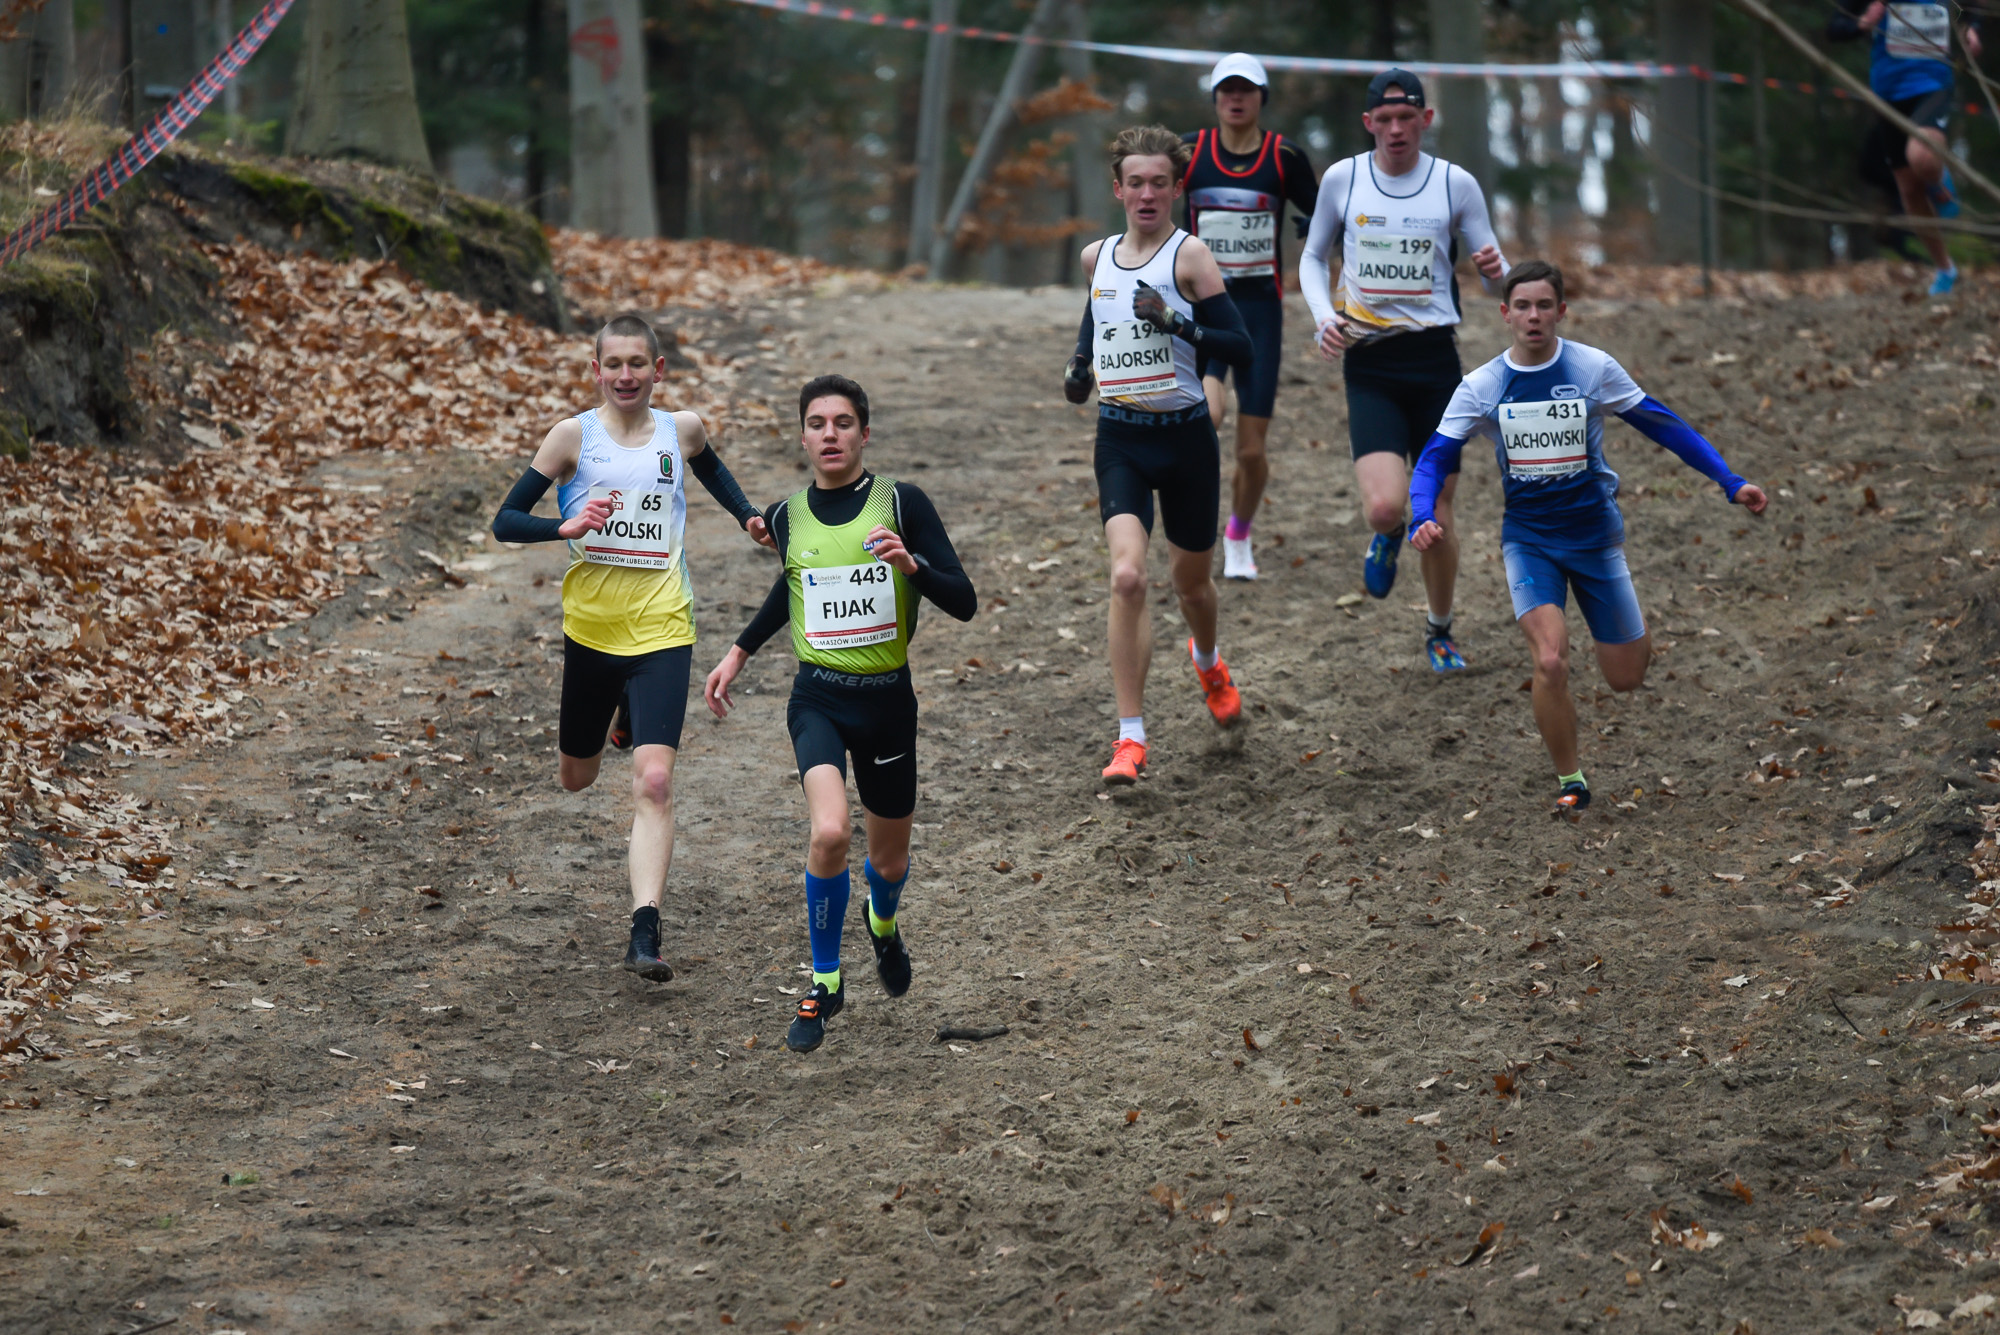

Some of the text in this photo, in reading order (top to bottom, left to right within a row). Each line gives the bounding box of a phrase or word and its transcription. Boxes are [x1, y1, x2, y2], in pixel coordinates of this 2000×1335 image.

[1241, 214, 1269, 230] 377
[1400, 239, 1432, 254] 199
[1358, 262, 1430, 280] JANDUŁA
[1102, 328, 1117, 341] 4F
[1100, 347, 1170, 370] BAJORSKI
[1546, 403, 1582, 419] 431
[1505, 429, 1584, 450] LACHOWSKI
[641, 494, 662, 511] 65
[589, 554, 626, 563] TOMASZÓW
[849, 565, 887, 586] 443
[822, 597, 876, 619] FIJAK
[810, 638, 849, 646] TOMASZÓW
[850, 634, 879, 644] LUBELSKI
[880, 630, 894, 639] 2021
[812, 668, 899, 687] NIKE PRO
